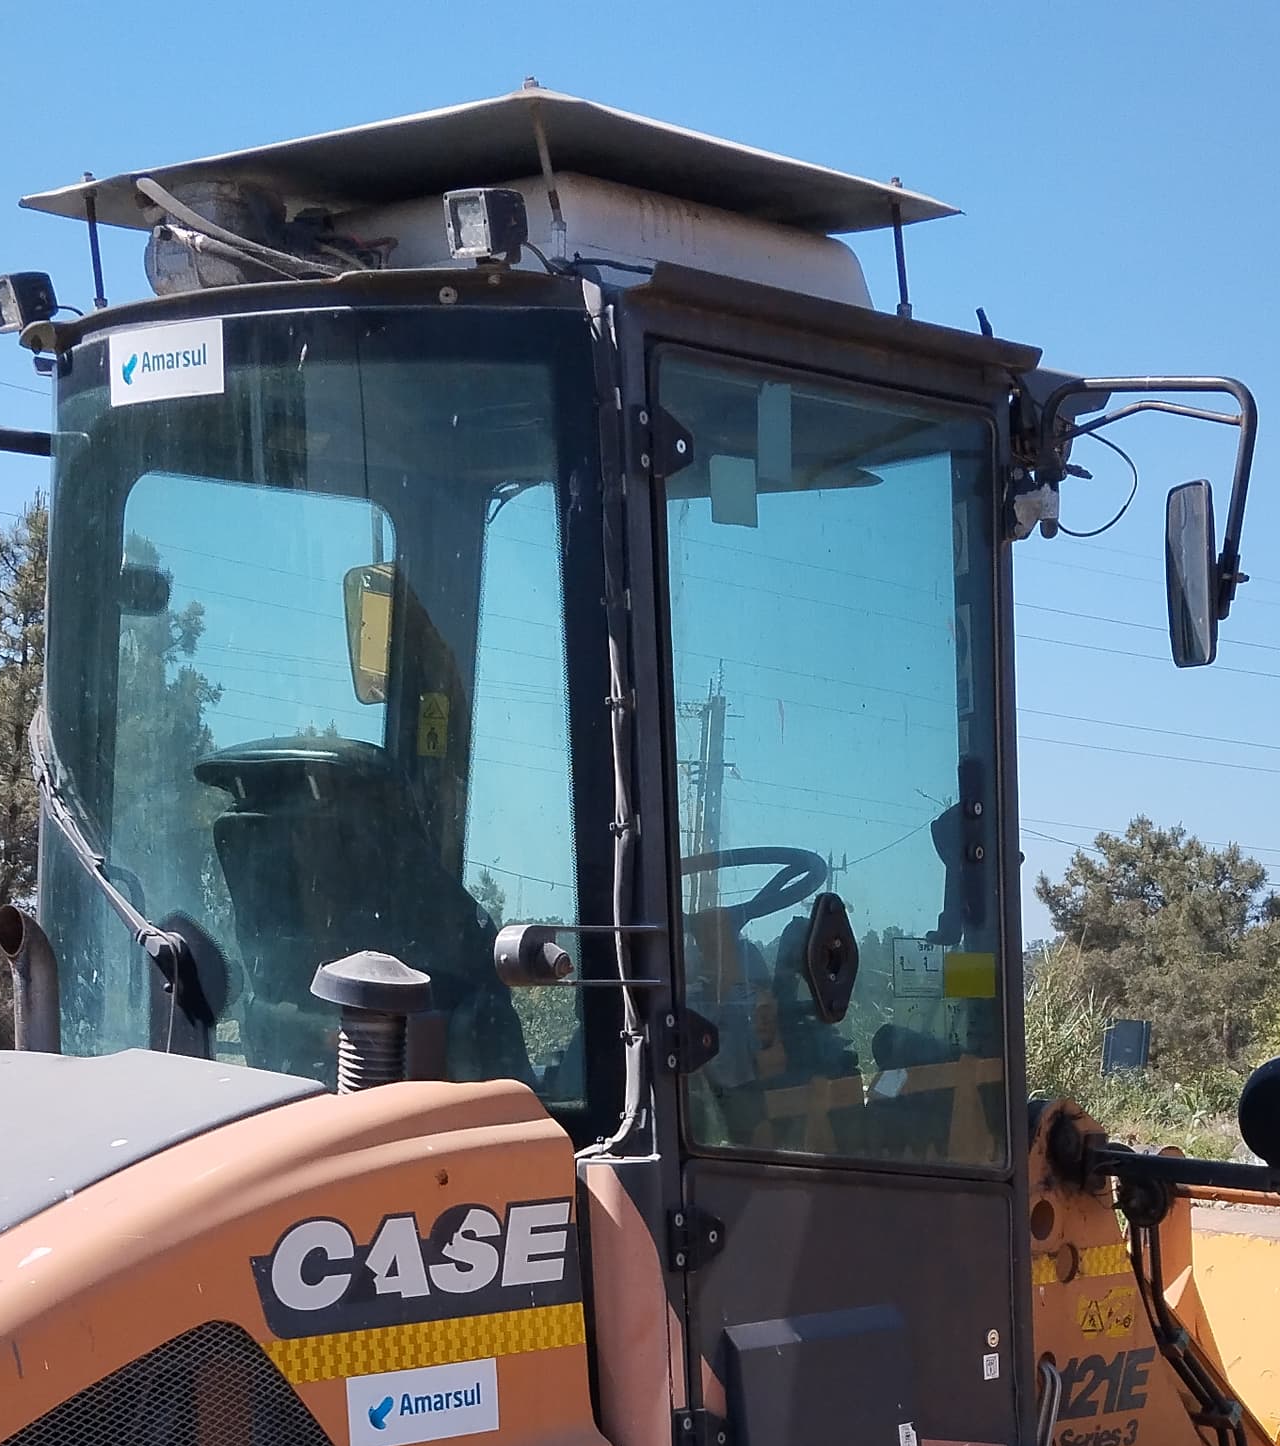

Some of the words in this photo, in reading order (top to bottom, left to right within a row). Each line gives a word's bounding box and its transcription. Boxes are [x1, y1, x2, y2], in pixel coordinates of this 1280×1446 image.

[141, 342, 207, 373] Amarsul
[271, 1201, 571, 1311] CASE
[399, 1382, 481, 1416] Amarsul
[1123, 1419, 1139, 1446] 3
